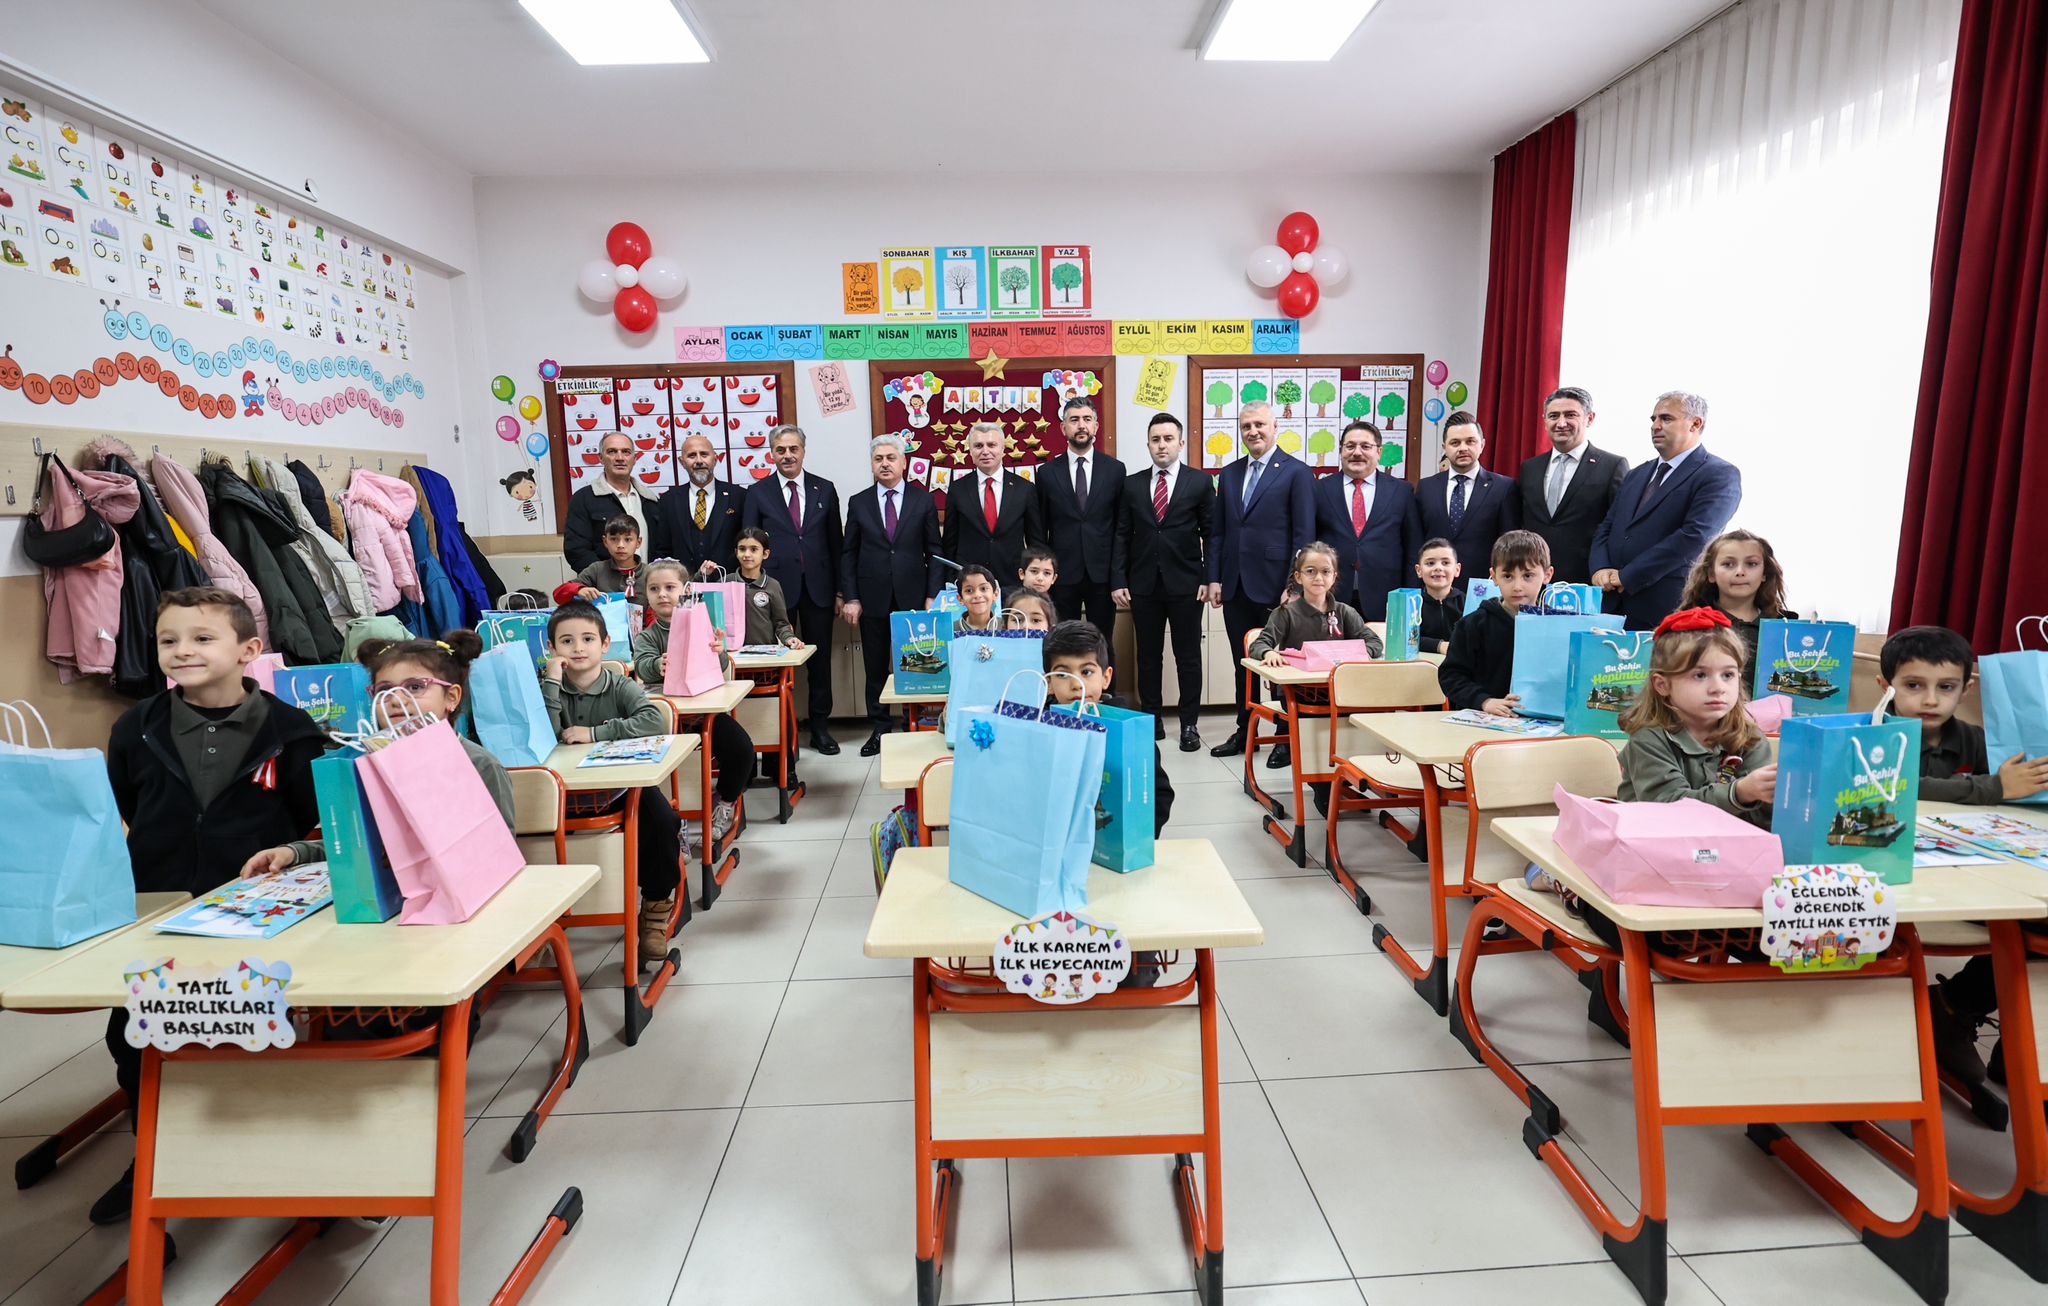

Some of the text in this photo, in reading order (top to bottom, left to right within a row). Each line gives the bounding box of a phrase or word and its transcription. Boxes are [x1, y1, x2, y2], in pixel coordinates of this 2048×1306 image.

[6, 126, 35, 151] C c
[58, 146, 85, 172] Ç ç
[107, 163, 130, 186] D d
[150, 180, 170, 201] E e
[189, 195, 206, 213] F f
[223, 209, 243, 232] G g
[255, 218, 264, 235] Ğ
[45, 228, 74, 249] O o
[285, 232, 293, 247] H
[93, 238, 120, 262] Ö ö
[883, 250, 930, 258] SONBAHAR
[952, 250, 967, 259] KIŞ
[992, 248, 1035, 256] İLKBAHAR
[140, 254, 162, 279] P p
[179, 265, 188, 281] R
[215, 276, 222, 290] S
[278, 294, 284, 307] T
[305, 303, 313, 315] U
[684, 322, 1292, 346] AYLAR OCAK ŞUBAT MART NİSAN MAYIS HAZİRAN TEMMUZ AĞUSTOS EYLÜL EKİM KASIM ARALIK
[135, 319, 143, 331] 5
[156, 330, 168, 344] 10
[179, 344, 189, 357] 15
[198, 358, 210, 370] 20
[218, 357, 228, 369] 25
[231, 349, 243, 361] 30
[247, 341, 257, 354] 35
[263, 345, 274, 356] 40
[280, 356, 290, 367] 45
[295, 366, 305, 377] 50
[310, 364, 319, 375] 55
[324, 362, 333, 372] 60
[338, 361, 346, 372] 65
[350, 360, 358, 370] 70
[385, 387, 393, 397] 85
[1362, 367, 1401, 377] ETKİNLİK
[30, 358, 232, 411] 10 20 30 40 50 60 70 80 90 100
[557, 380, 599, 391] ETKİNLİK
[948, 389, 1038, 404] ARTIK
[286, 403, 292, 414] 2
[301, 409, 307, 419] 4
[315, 408, 320, 417] 6
[326, 402, 331, 412] 8
[337, 398, 344, 408] 10
[349, 392, 356, 402] 12
[360, 393, 367, 403] 14
[372, 402, 379, 412] 16
[394, 413, 401, 423] 20
[1604, 664, 1617, 673] Bu
[1791, 886, 1865, 898] EĞLENDİK,
[1794, 901, 1866, 914] ÖĞRENDİK
[1769, 915, 1890, 930] TATİLİ HAK ETTİK
[1013, 939, 1111, 953] İLK KARNEM
[1000, 956, 1123, 970] İLK HEYECANIM
[177, 978, 233, 995] TATİL
[140, 1000, 276, 1015] HAZIRLIKLARI
[163, 1021, 255, 1038] BAŞLASIN
